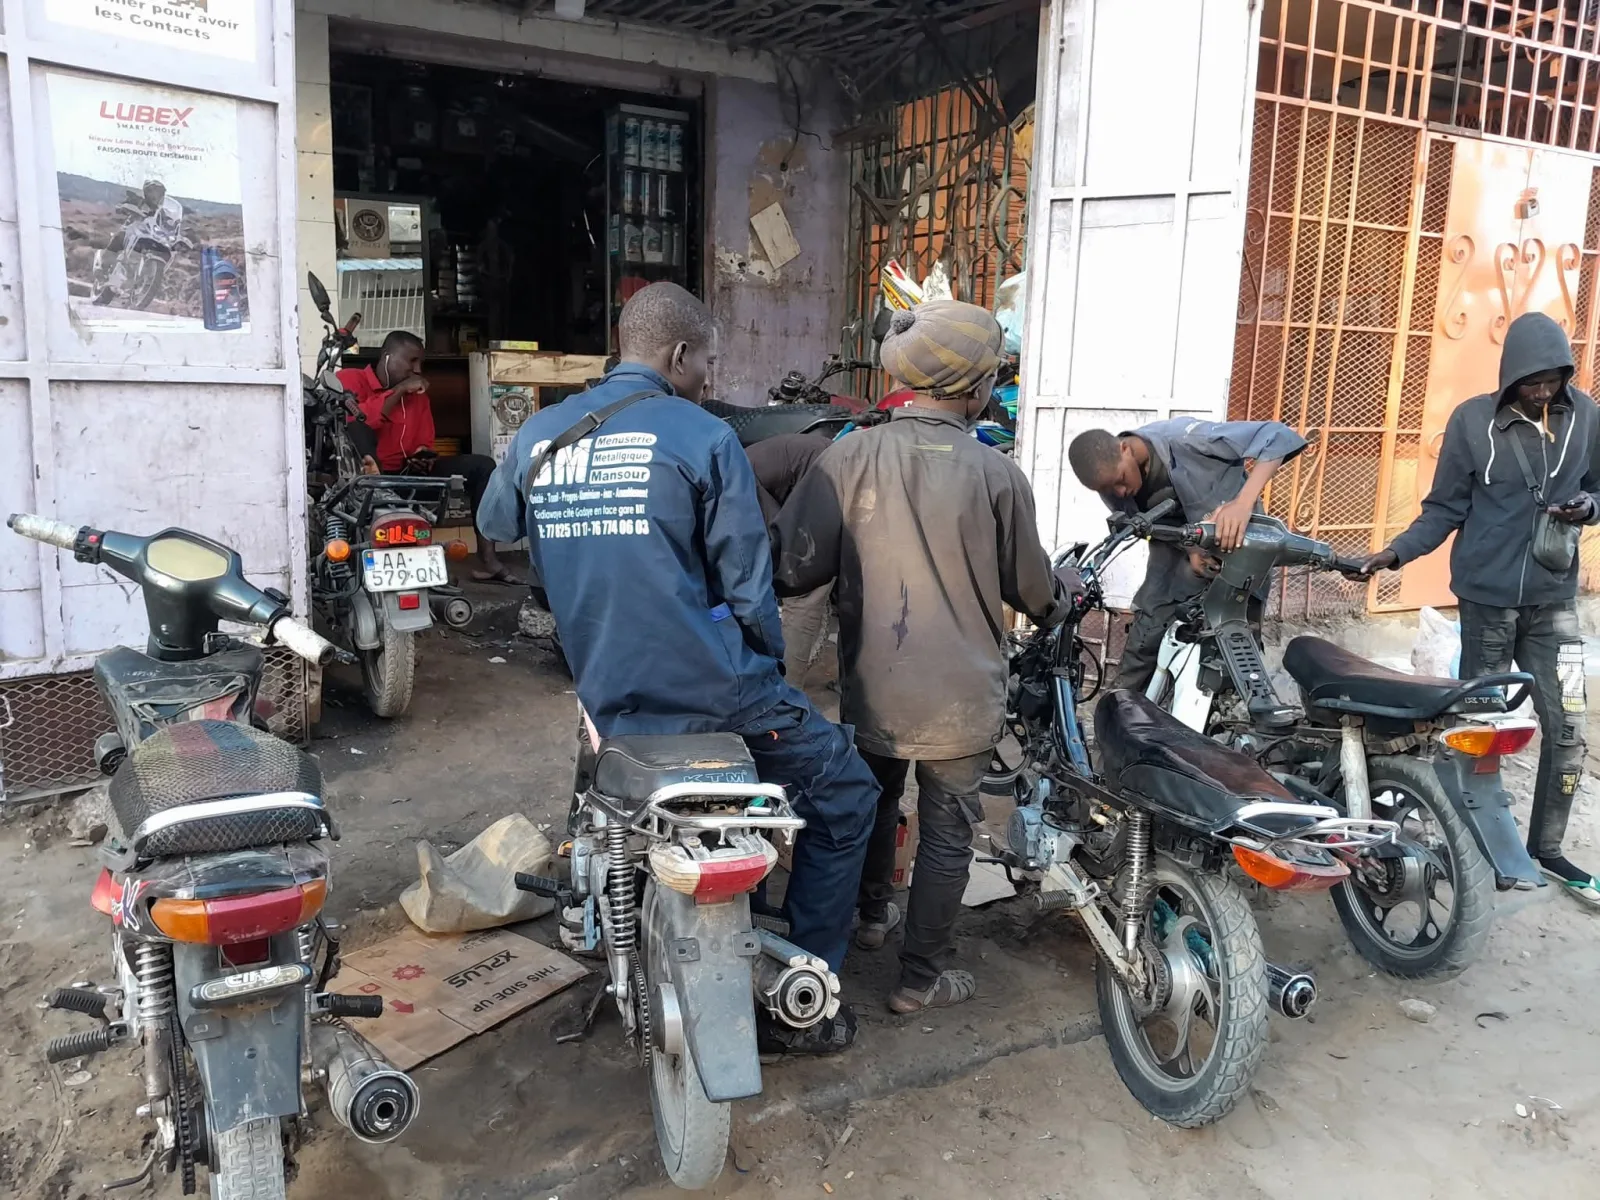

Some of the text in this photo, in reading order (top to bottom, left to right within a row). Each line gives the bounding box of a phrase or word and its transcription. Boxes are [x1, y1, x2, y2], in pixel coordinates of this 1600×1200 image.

[94, 5, 211, 40] les Contacts
[151, 4, 192, 20] pour
[198, 15, 239, 30] avoir
[99, 100, 194, 128] LUBEX
[116, 122, 181, 135] SMART CHOICE
[132, 149, 158, 158] ROUTE
[159, 152, 198, 161] ENSEMBLE
[591, 470, 648, 482] Mansour
[372, 566, 443, 586] 579 QN
[447, 951, 519, 988] XPLUS
[472, 964, 560, 1013] THIS SIDE UP
